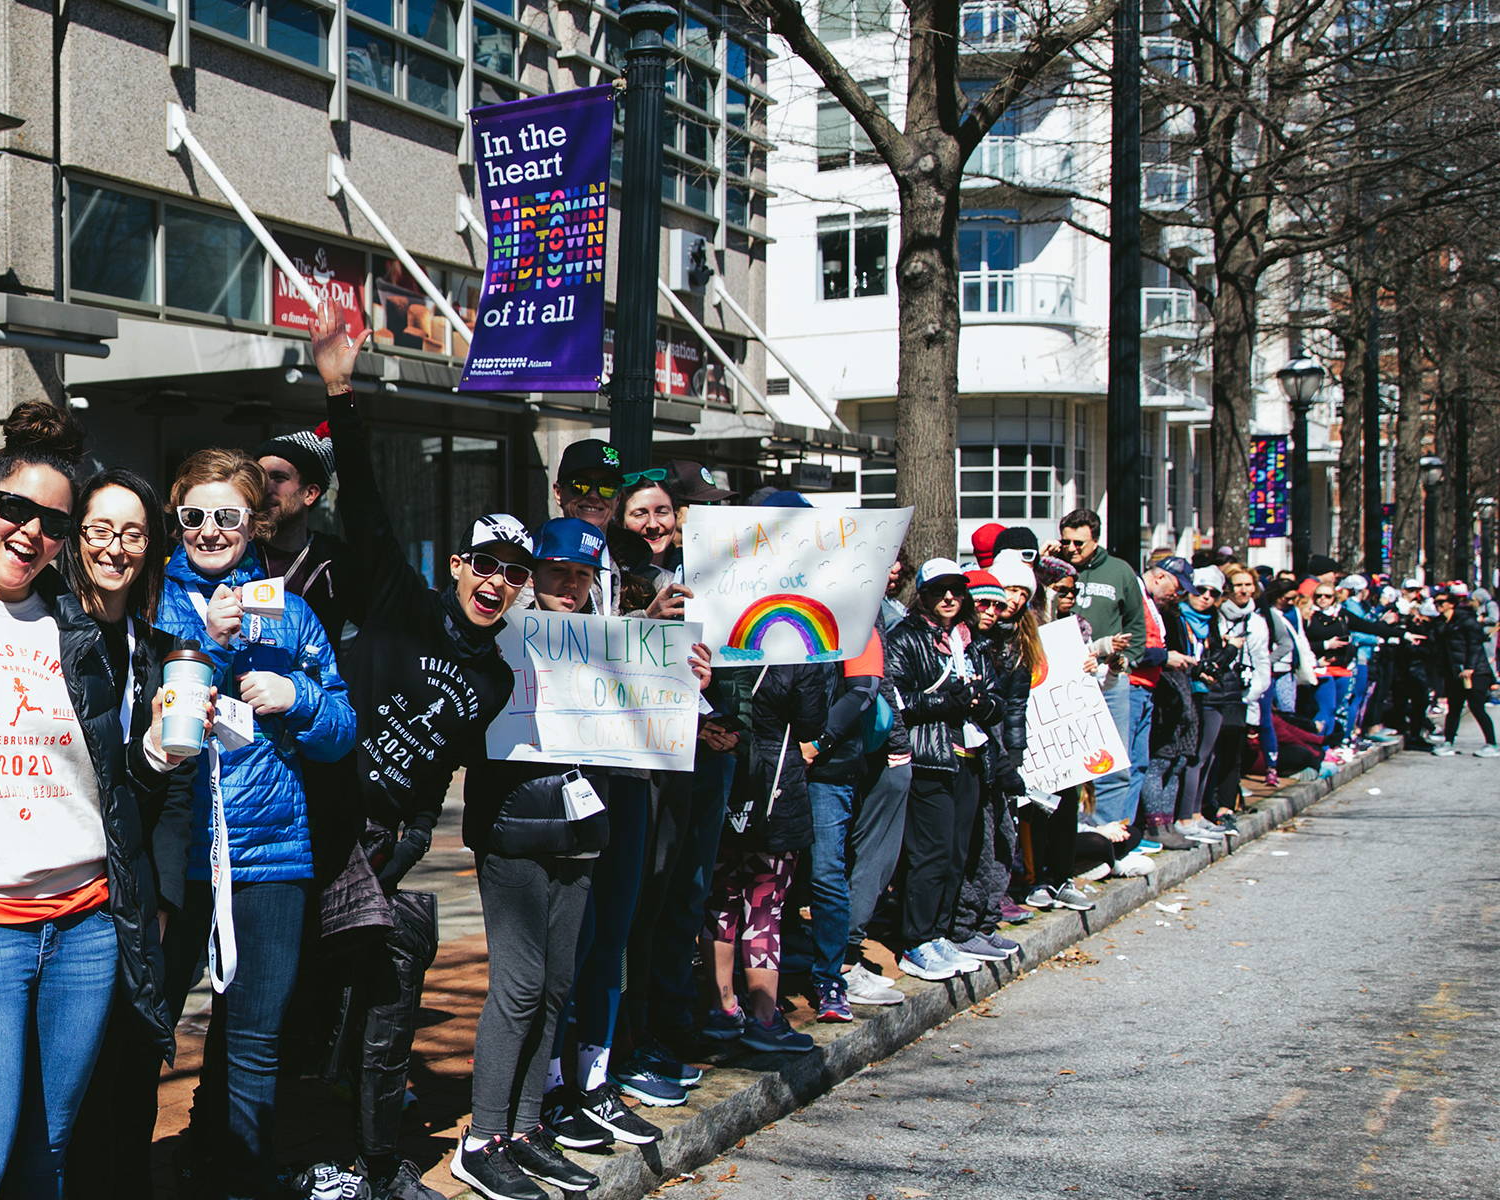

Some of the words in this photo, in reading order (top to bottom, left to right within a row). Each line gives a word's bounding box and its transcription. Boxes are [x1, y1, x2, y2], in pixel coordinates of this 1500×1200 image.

[480, 131, 513, 158] In
[518, 123, 567, 151] the
[485, 152, 563, 187] heart
[483, 301, 514, 328] of
[516, 300, 536, 325] it
[541, 295, 575, 324] all
[471, 357, 528, 369] MIDTOWN
[779, 572, 809, 589] out
[523, 616, 589, 664] RUN
[604, 619, 684, 667] LIKE
[510, 669, 555, 707] THE
[43, 735, 56, 746] 29
[377, 730, 414, 769] 2020
[387, 716, 420, 748] FEBRUARY
[212, 799, 220, 862] TENACIOUS
